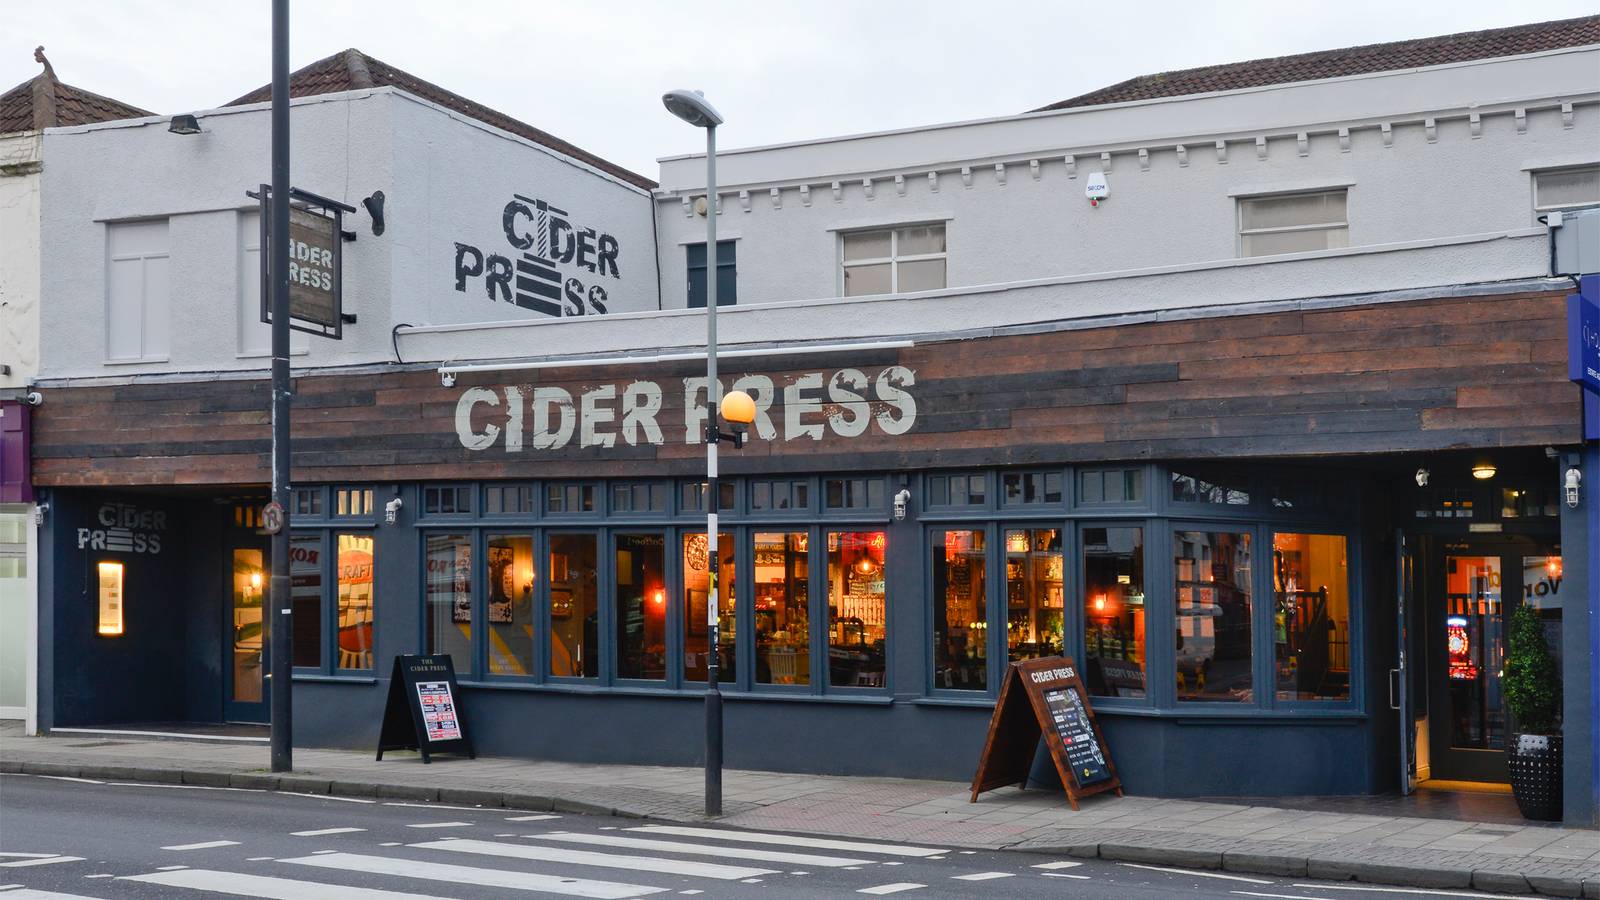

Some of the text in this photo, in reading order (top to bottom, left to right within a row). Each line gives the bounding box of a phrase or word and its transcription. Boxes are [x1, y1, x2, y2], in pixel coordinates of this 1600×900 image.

[502, 194, 621, 279] CIDER
[289, 239, 333, 269] IDER
[289, 262, 332, 292] RESS
[454, 242, 609, 318] PRESS
[455, 365, 918, 452] CIDER PRESS
[98, 503, 167, 530] CIDER
[77, 528, 161, 554] PRESS
[1030, 667, 1075, 684] CIDER PRESS
